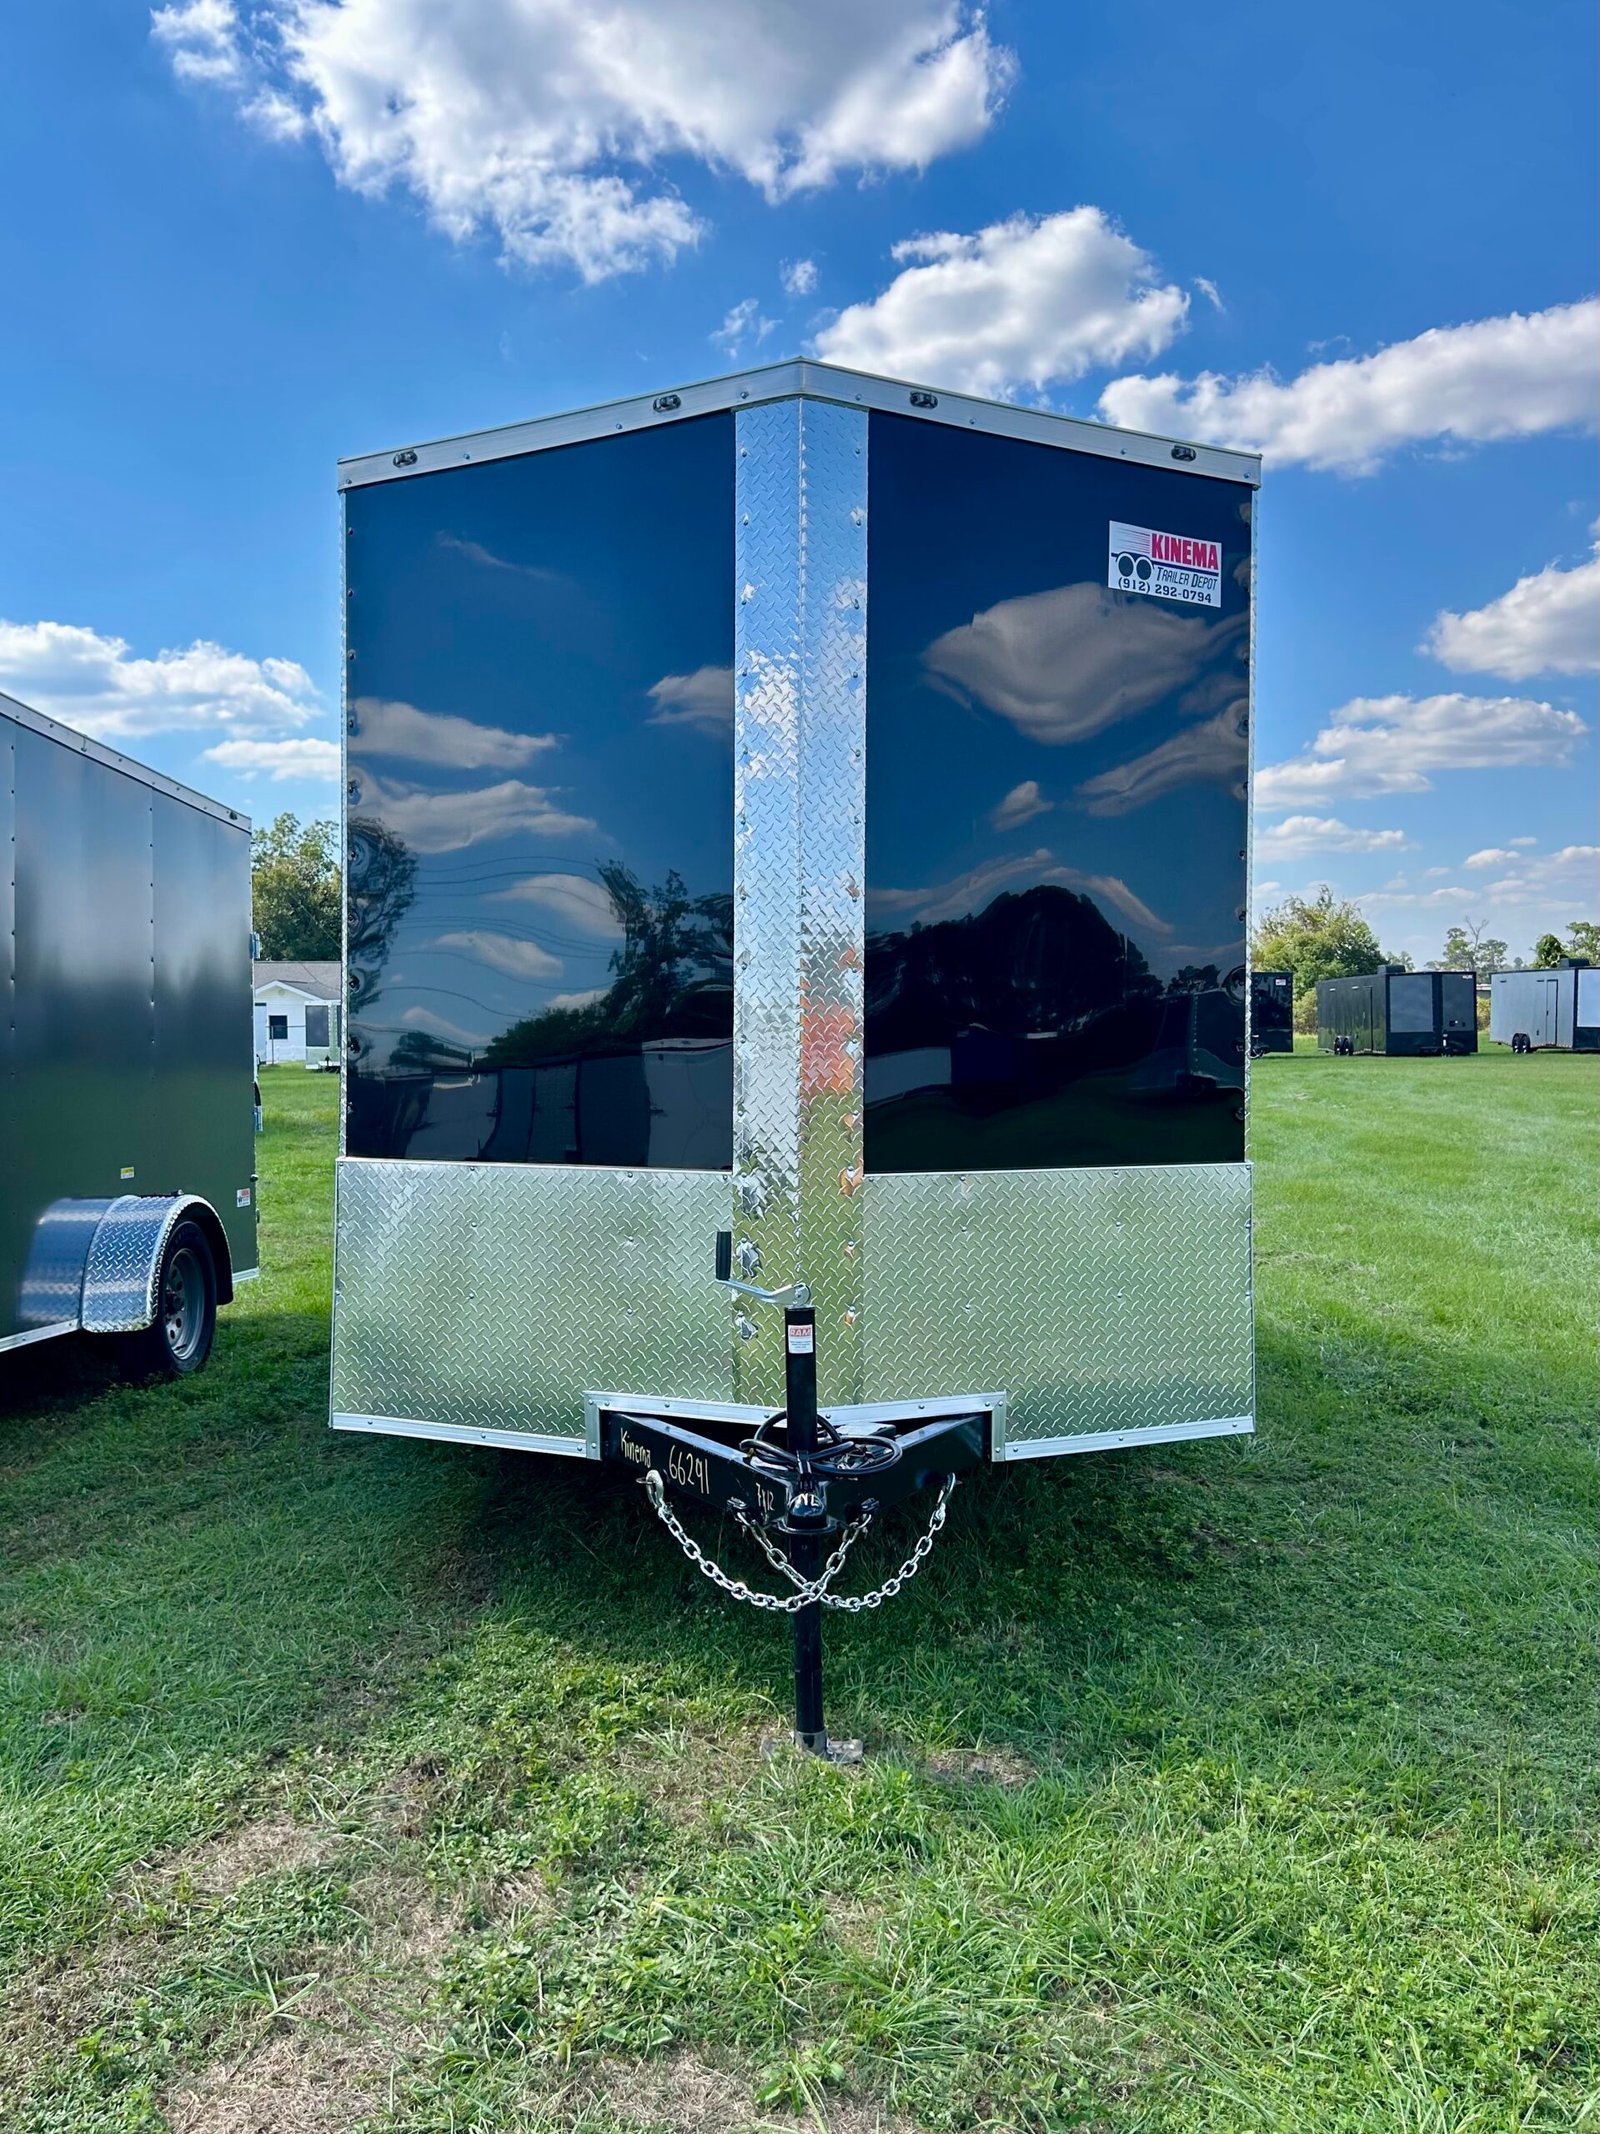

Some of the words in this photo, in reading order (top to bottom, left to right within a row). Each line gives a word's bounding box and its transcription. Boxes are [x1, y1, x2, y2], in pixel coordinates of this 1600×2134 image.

[1151, 533, 1219, 570] KINEMA
[1118, 577, 1151, 594] (912)
[1155, 584, 1212, 603] 292-0794
[1156, 566, 1189, 586] TRAILER
[1191, 574, 1218, 591] DEPOT
[620, 1427, 651, 1468] Kinema
[668, 1444, 710, 1494] 66291
